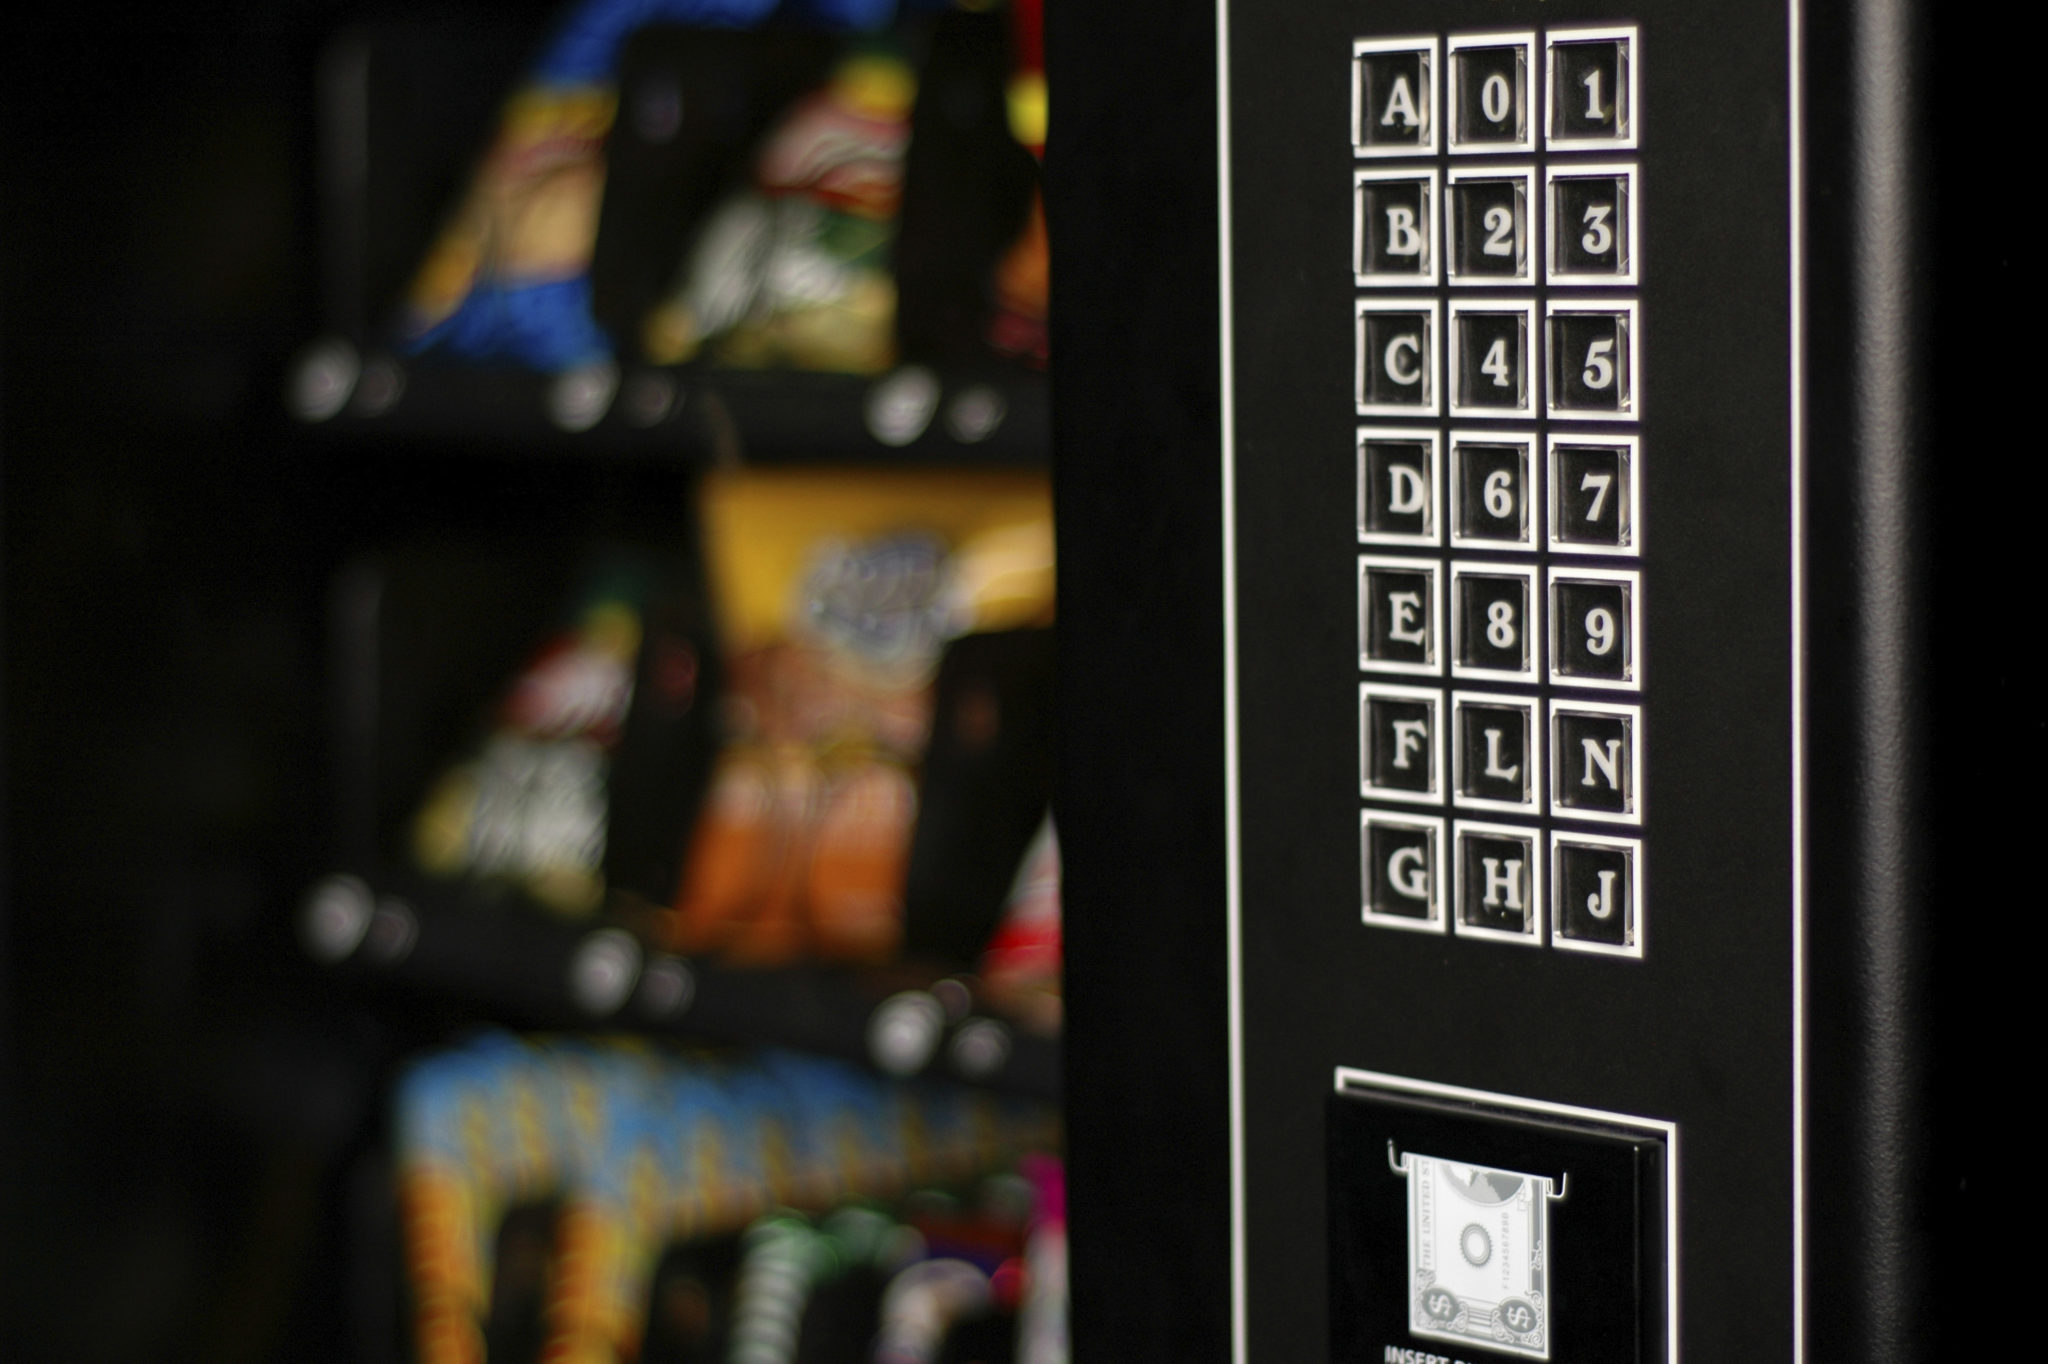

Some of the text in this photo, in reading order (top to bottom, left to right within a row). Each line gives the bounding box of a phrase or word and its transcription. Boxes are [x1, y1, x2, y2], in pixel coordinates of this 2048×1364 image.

[1380, 76, 1420, 126] A
[1481, 74, 1510, 123] 0
[1583, 69, 1604, 119] 1
[1386, 207, 1421, 256] B
[1483, 207, 1513, 257] 2
[1582, 205, 1613, 255] 3
[1384, 335, 1421, 385] C
[1481, 339, 1509, 387] 4
[1583, 338, 1614, 390] 5
[1389, 464, 1424, 514] D
[1483, 470, 1513, 519] 6
[1580, 472, 1611, 522] 7
[1388, 591, 1426, 646] E
[1486, 601, 1516, 649] 8
[1585, 607, 1615, 656] 9
[1392, 719, 1428, 770] F
[1484, 728, 1519, 782] L
[1581, 738, 1622, 790] N
[1388, 846, 1428, 899] G
[1482, 857, 1523, 910] H
[1587, 870, 1617, 919] J
